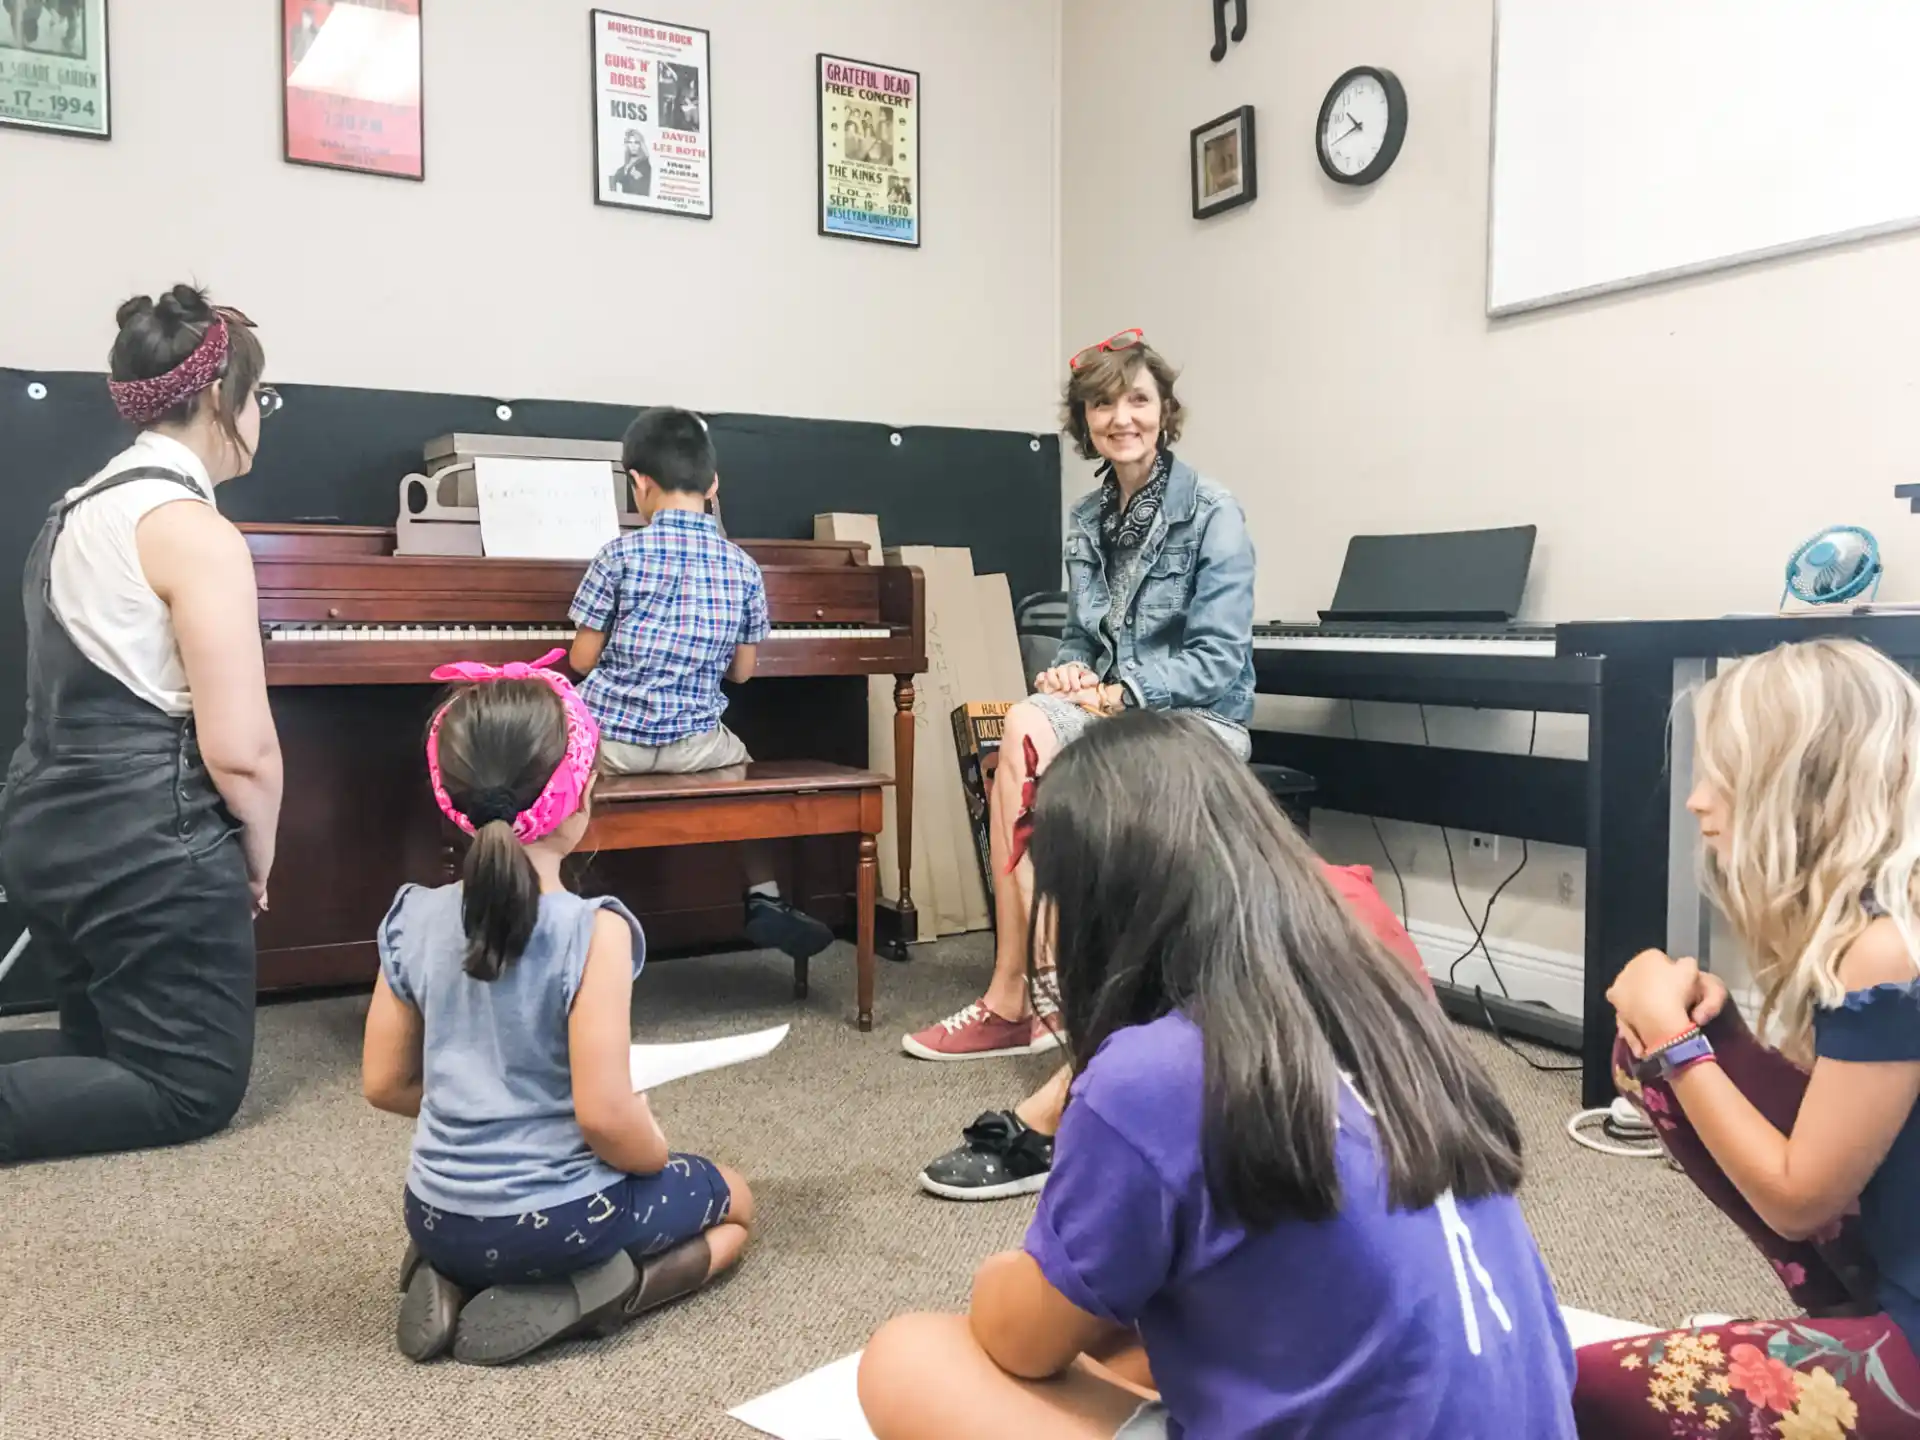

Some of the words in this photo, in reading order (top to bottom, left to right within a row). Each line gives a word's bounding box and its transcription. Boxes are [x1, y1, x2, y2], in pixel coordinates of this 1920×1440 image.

[607, 20, 656, 40] MONSTERS
[656, 31, 668, 41] OF
[669, 32, 693, 46] ROCK
[604, 53, 636, 71] GUNS
[610, 71, 646, 90] ROSES
[827, 63, 879, 90] GRATEFUL
[884, 74, 910, 96] DEAD
[14, 90, 31, 108] 17
[50, 95, 95, 117] 1994
[825, 82, 855, 98] FREE
[858, 88, 912, 109] CONCERT
[610, 99, 647, 122] KISS
[662, 131, 697, 144] DAVID
[653, 142, 673, 153] LEE
[828, 164, 847, 178] THE
[851, 168, 883, 184] KINKS
[888, 204, 909, 218] 1970
[981, 703, 999, 715] HAL
